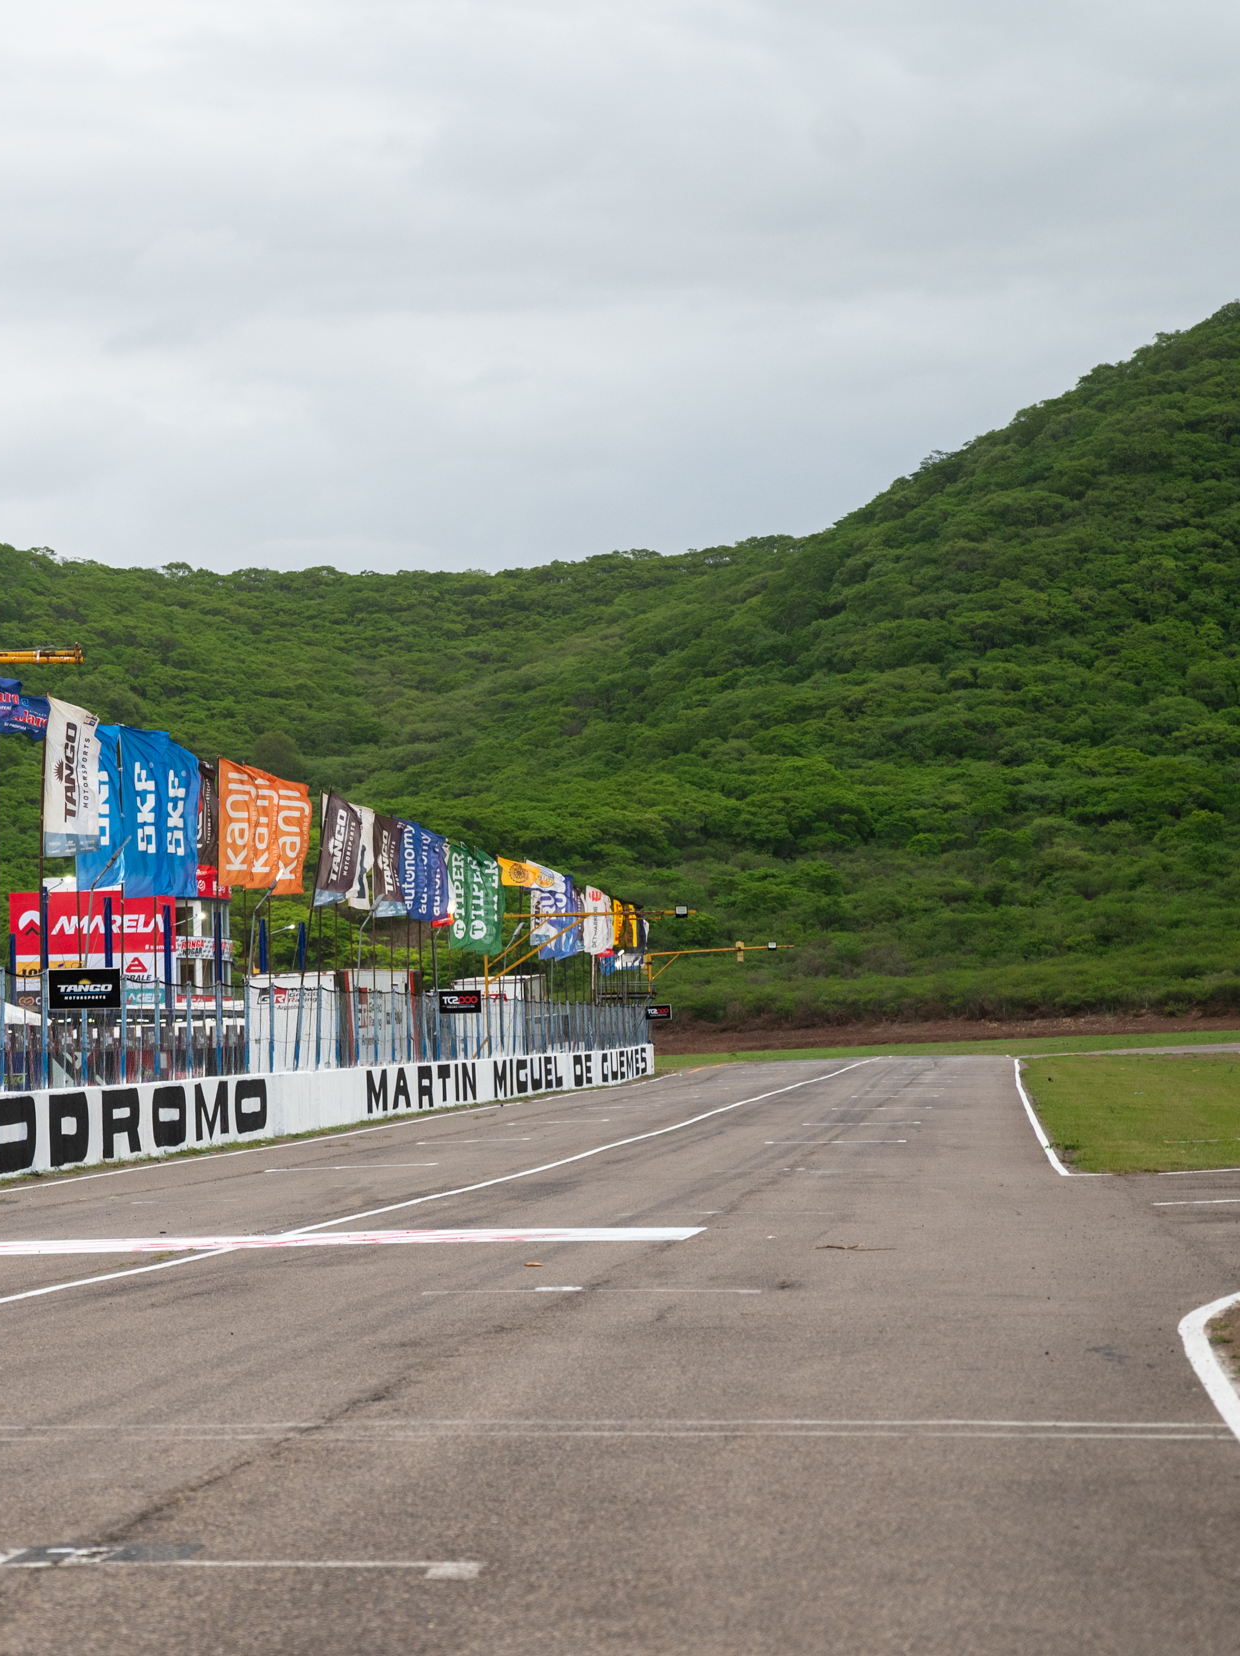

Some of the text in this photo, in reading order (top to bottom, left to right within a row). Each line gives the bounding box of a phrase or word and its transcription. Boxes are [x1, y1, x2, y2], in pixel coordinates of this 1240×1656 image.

[64, 721, 78, 823] TANGO
[82, 737, 91, 809] MOTORSPORTS
[134, 761, 156, 854] SKF
[167, 769, 186, 856] SKF
[226, 772, 257, 870] kanji
[278, 789, 310, 880] kanji
[328, 808, 347, 884] TANGO
[382, 829, 394, 895] TANGO
[57, 983, 113, 992] TANGO
[442, 995, 478, 1004] TC2000
[366, 1047, 647, 1114] MARTIN MIGUEL DE GUEMES
